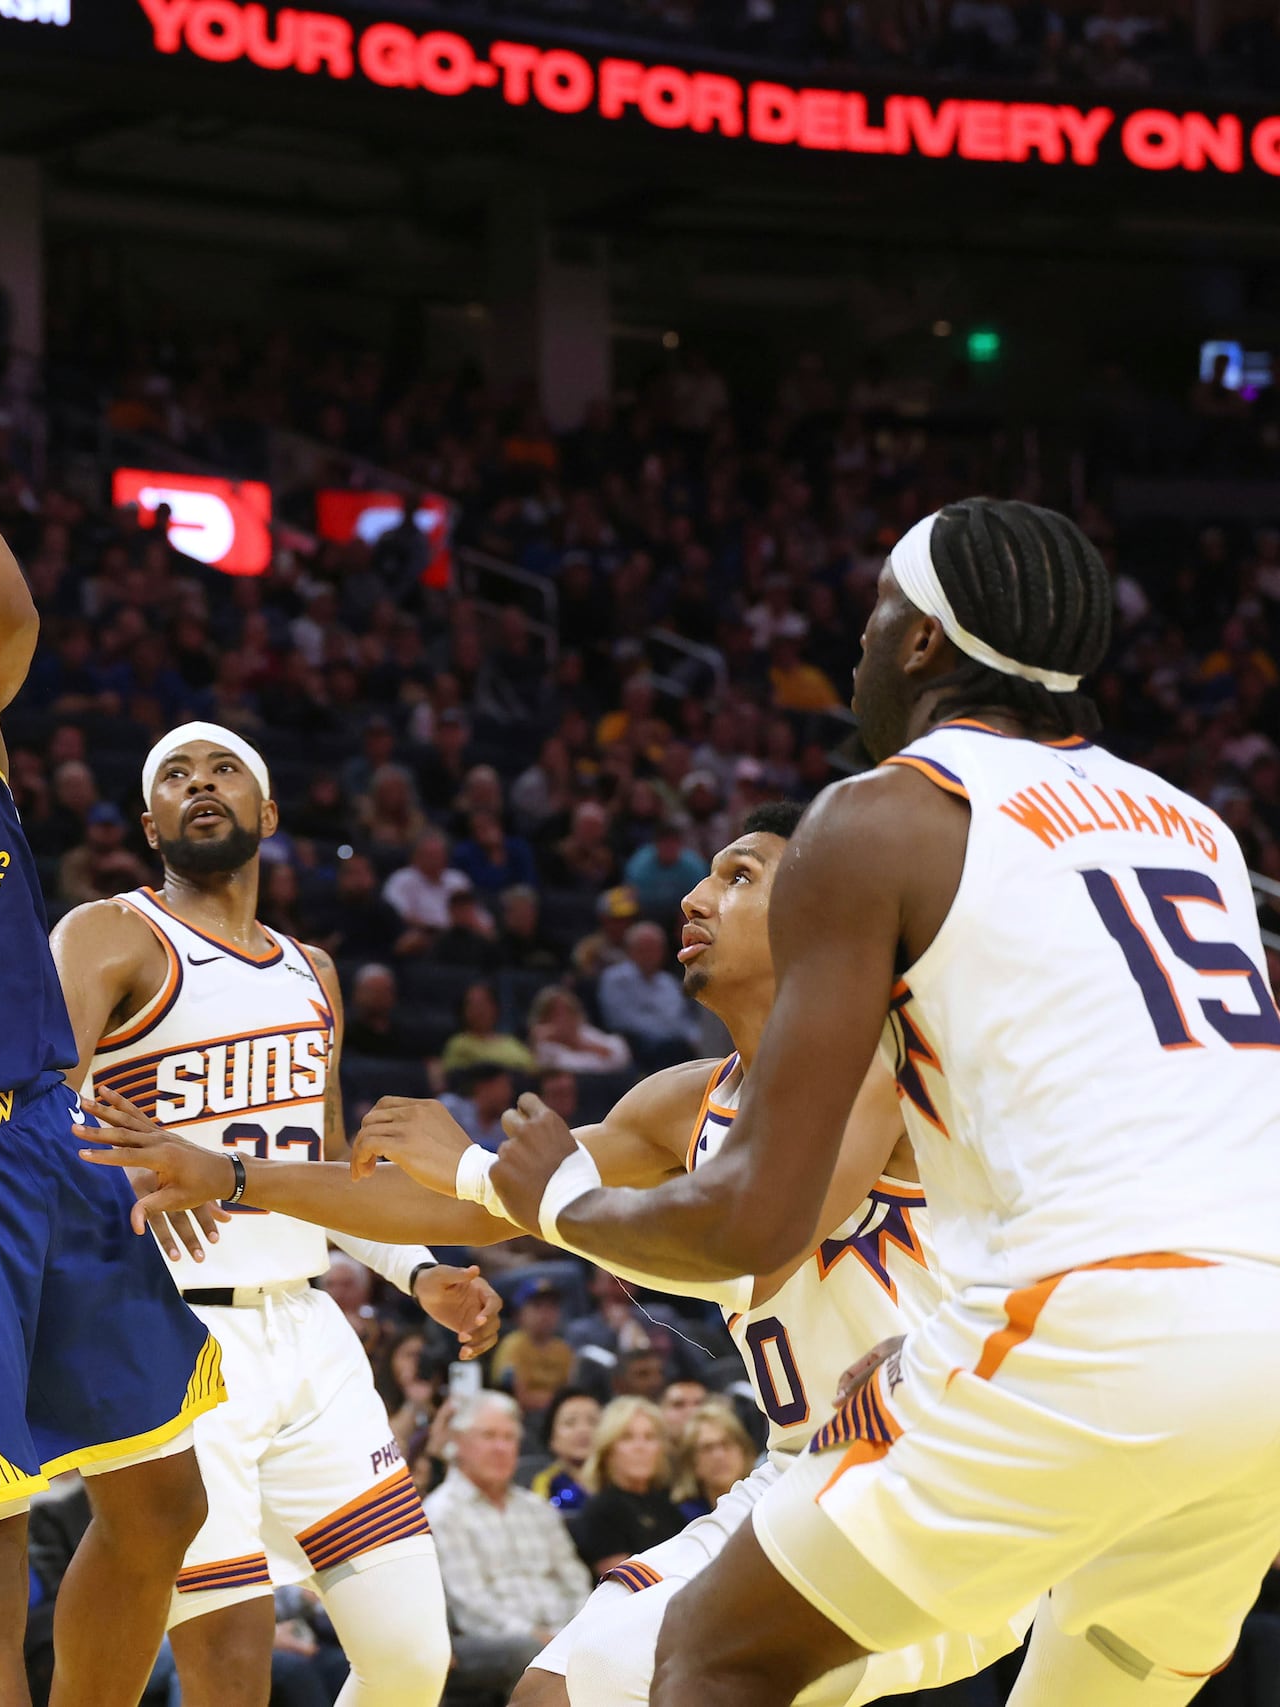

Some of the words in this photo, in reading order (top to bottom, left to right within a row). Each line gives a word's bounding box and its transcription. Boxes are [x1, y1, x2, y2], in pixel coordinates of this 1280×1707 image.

[138, 0, 354, 79] YOUR
[358, 22, 594, 113] GO-TO
[598, 58, 744, 137] FOR
[748, 81, 1114, 166] DELIVERY
[1121, 109, 1243, 173] ON
[998, 781, 1219, 863] WILLIAMS
[1076, 867, 1280, 1050] 15
[745, 1316, 811, 1429] 0
